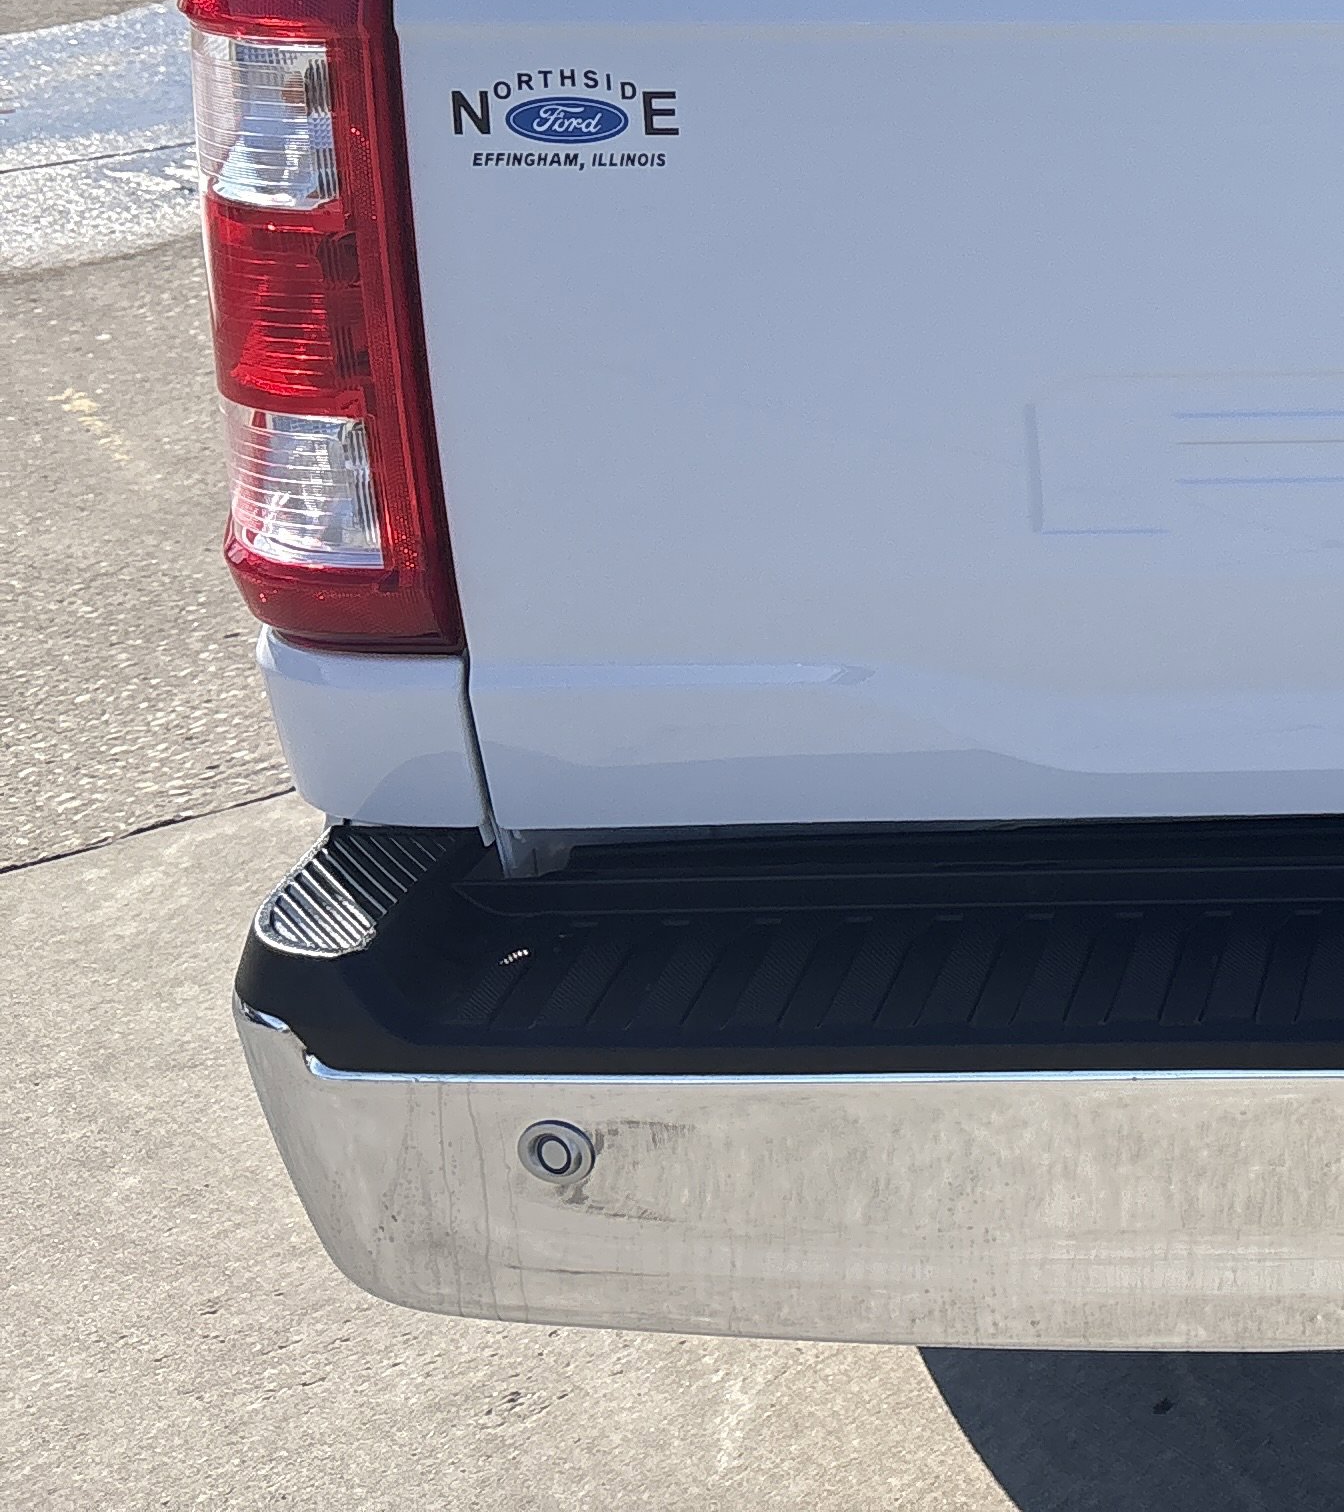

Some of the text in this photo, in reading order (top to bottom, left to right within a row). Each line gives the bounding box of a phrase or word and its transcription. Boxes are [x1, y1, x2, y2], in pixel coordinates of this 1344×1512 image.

[451, 68, 680, 136] NORTHSIDE
[532, 104, 602, 134] Ford
[472, 152, 667, 171] EFFINGHAM, ILLINOIS
